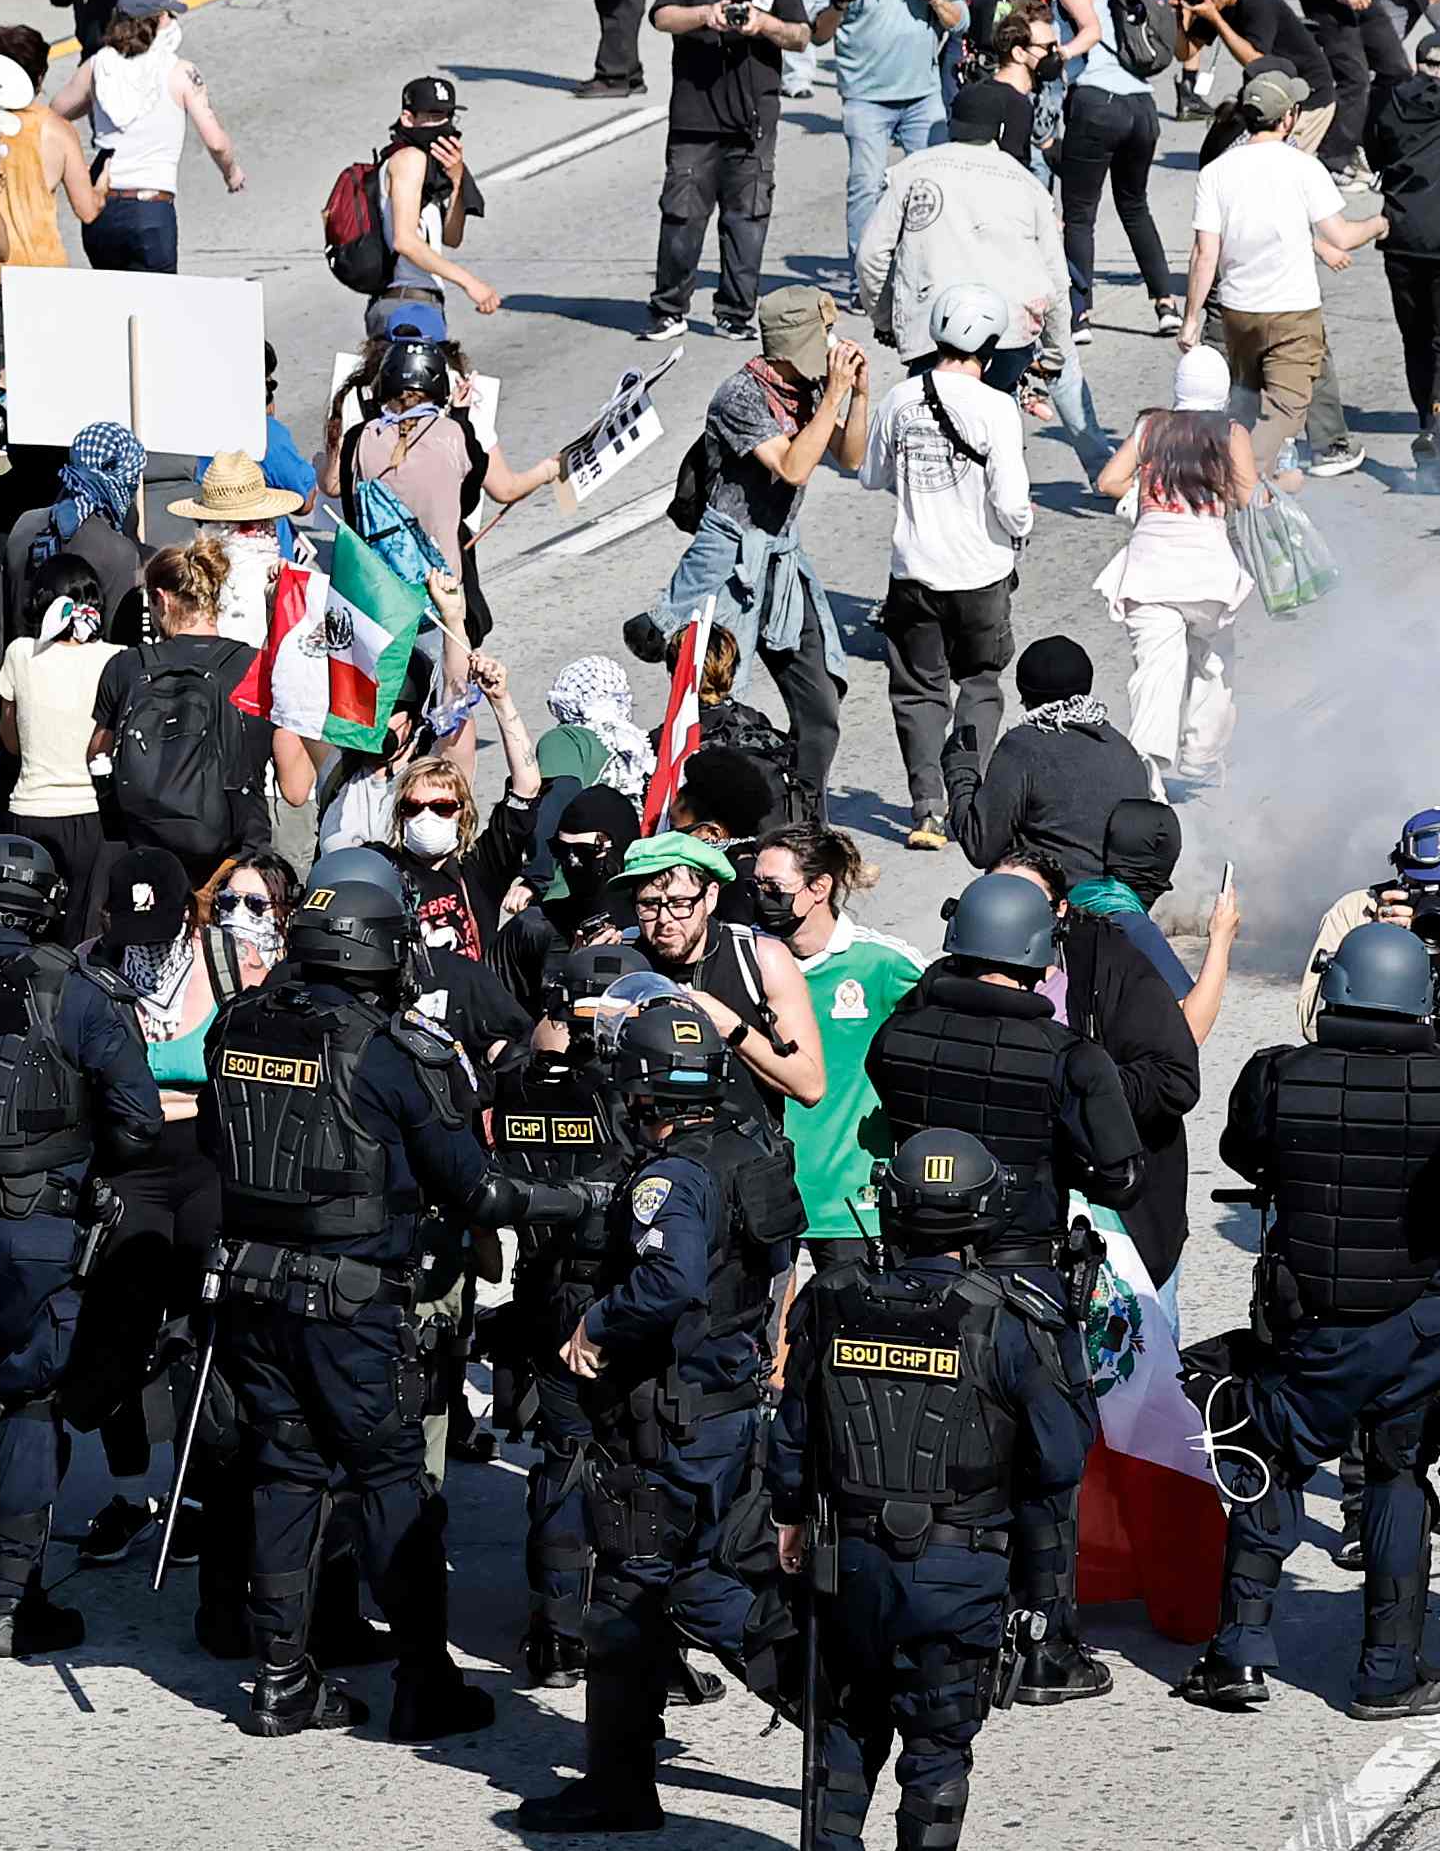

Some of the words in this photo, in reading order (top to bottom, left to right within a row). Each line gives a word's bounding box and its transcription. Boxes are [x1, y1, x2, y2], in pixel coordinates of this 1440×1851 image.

[228, 1056, 257, 1075] SOU
[264, 1062, 294, 1079] CHP
[510, 1121, 541, 1137] CHP
[557, 1122, 588, 1139] SOU
[840, 1344, 879, 1365] SOU
[888, 1349, 928, 1368] CHP
